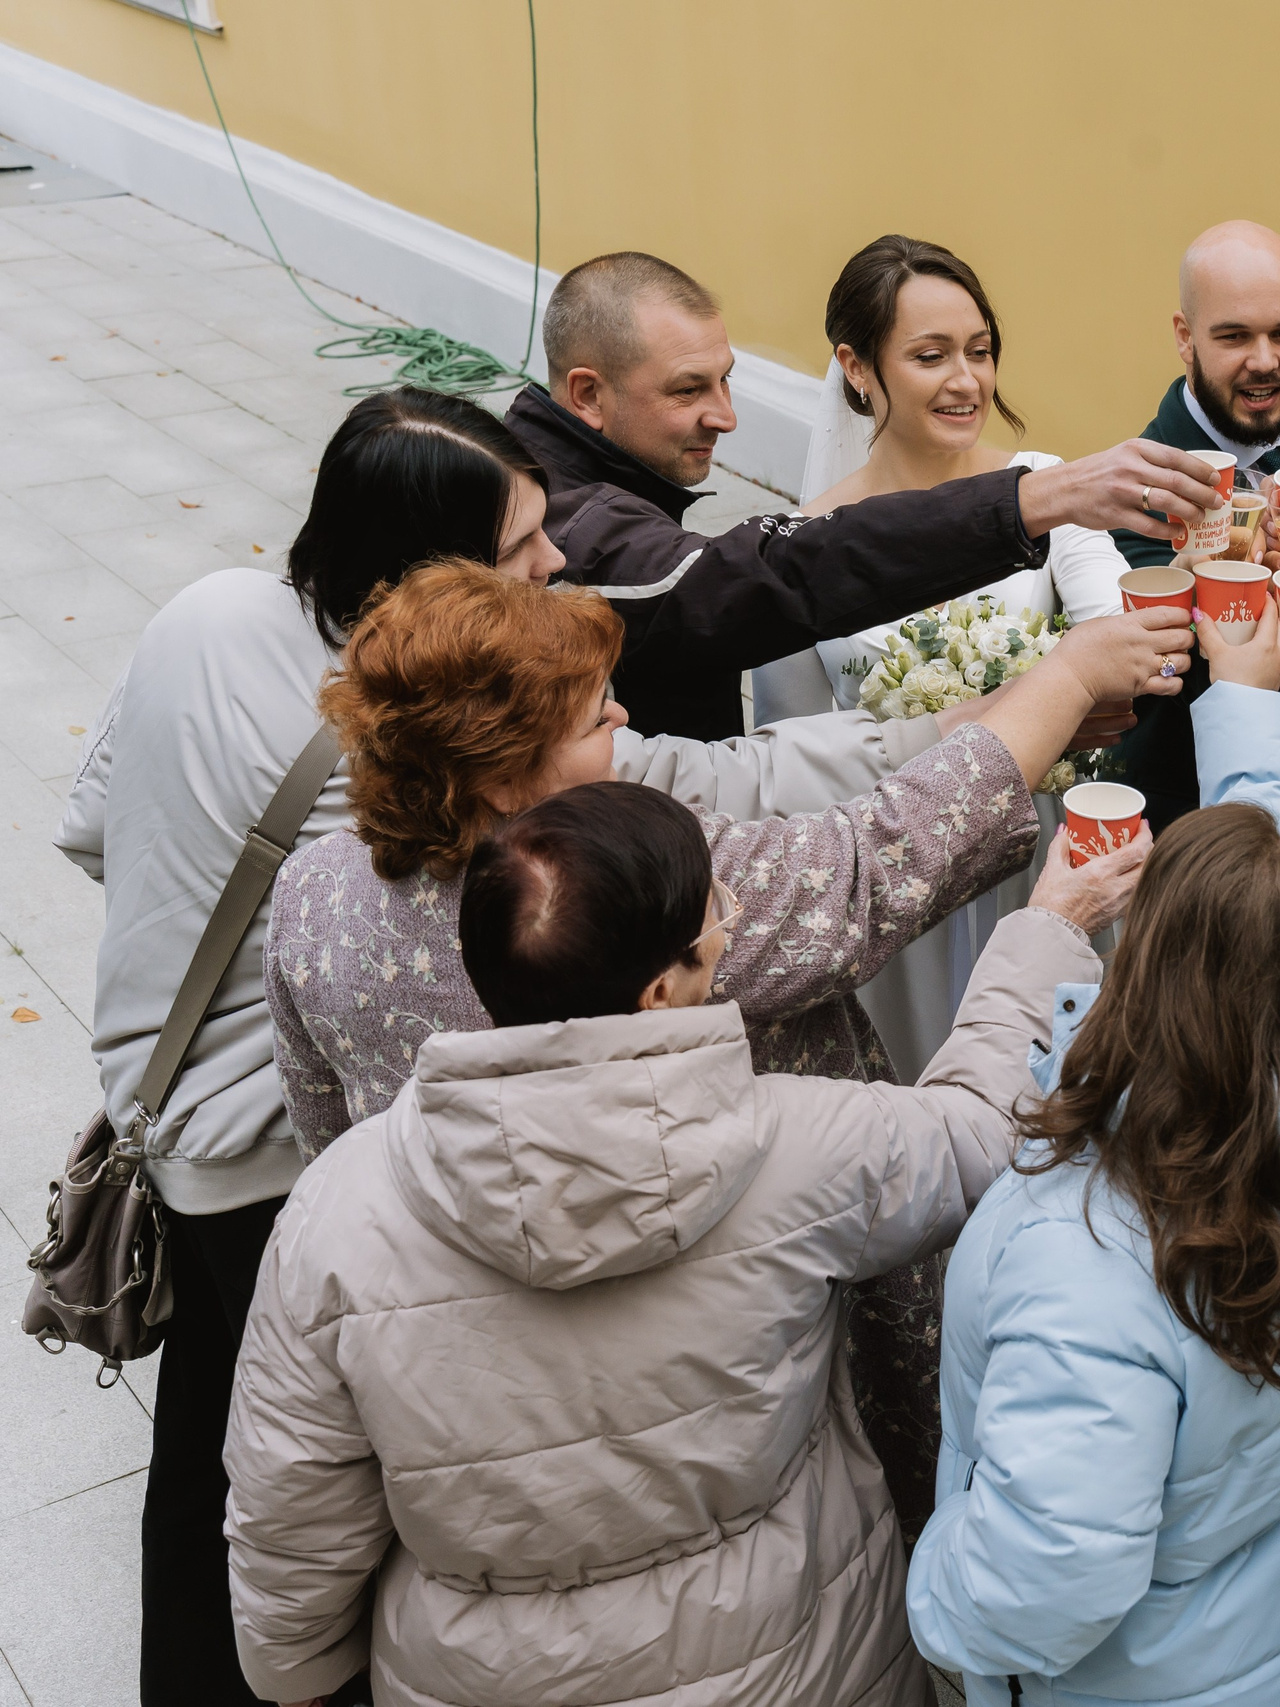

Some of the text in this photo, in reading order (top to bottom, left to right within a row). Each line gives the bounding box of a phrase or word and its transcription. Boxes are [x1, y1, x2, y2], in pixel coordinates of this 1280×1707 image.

[1196, 528, 1222, 539] ЛЮБИМЫЙ
[1195, 541, 1199, 549] И
[1203, 540, 1214, 548] НАШ
